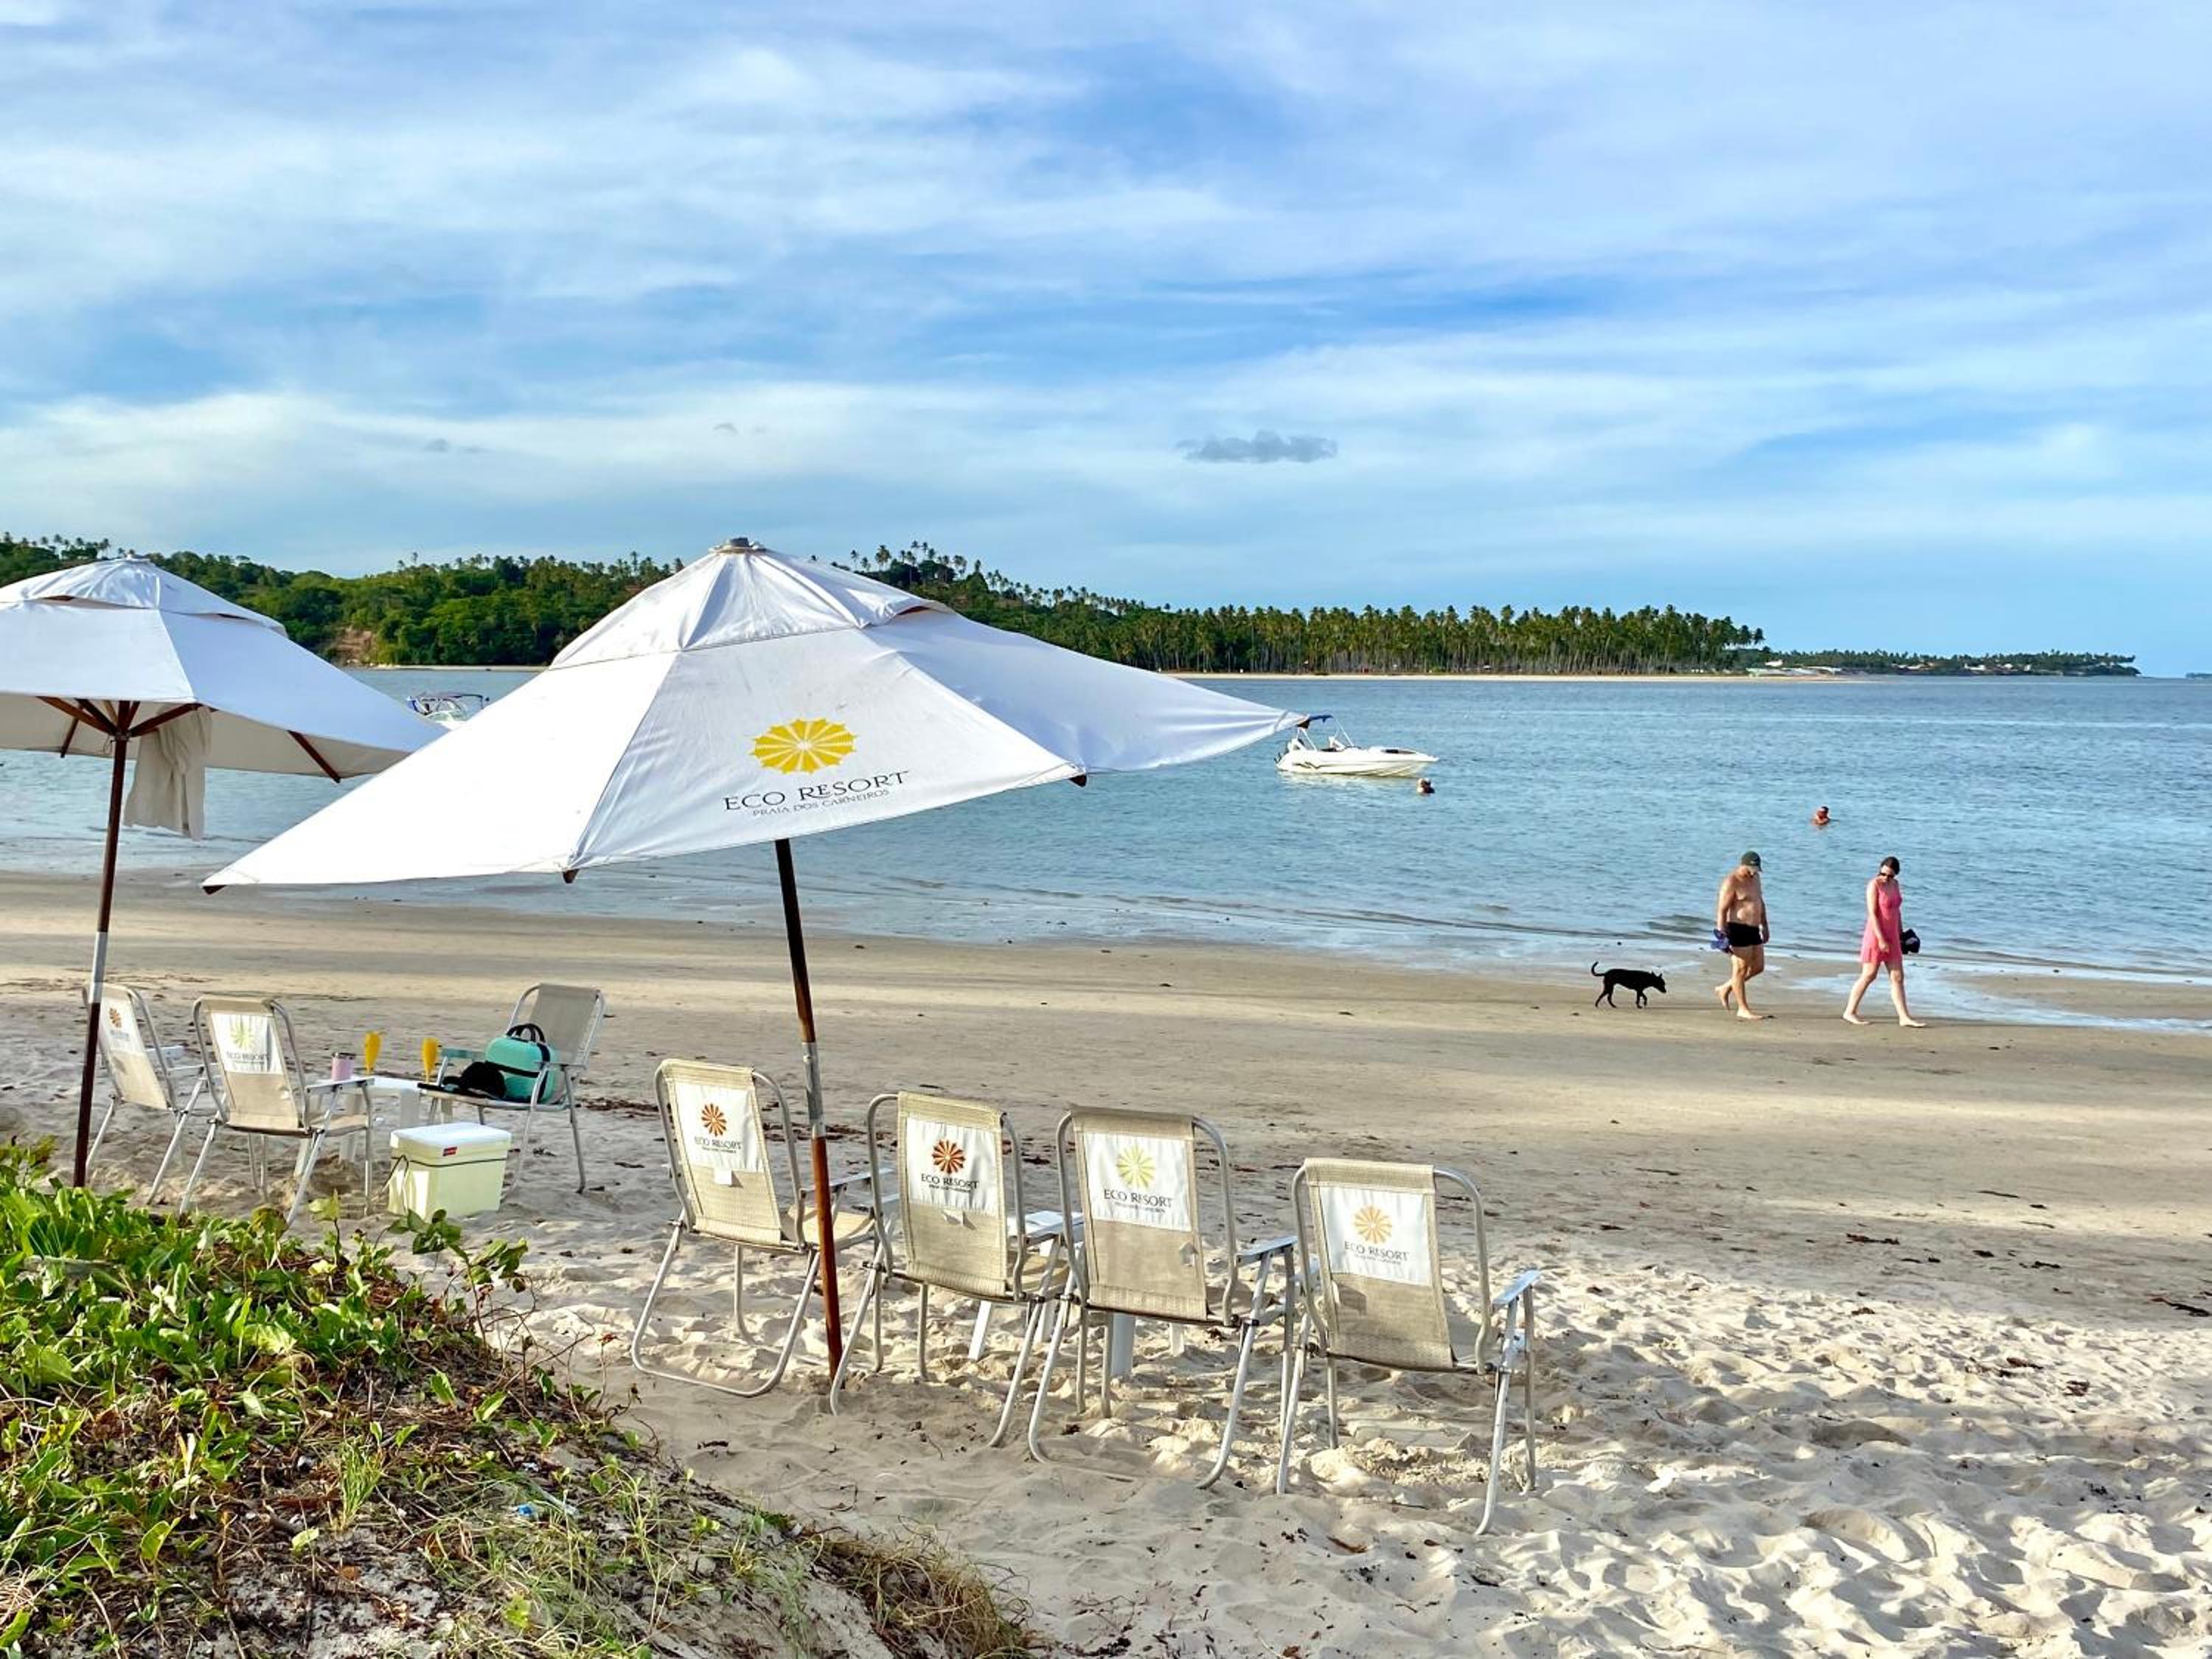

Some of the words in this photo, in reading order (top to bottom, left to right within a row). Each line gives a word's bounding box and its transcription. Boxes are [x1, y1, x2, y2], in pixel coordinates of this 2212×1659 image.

[723, 791, 785, 810] ECO
[799, 771, 908, 801] RESORT
[753, 806, 790, 816] PRAIA
[793, 801, 818, 812] DOS
[821, 789, 889, 807] CARNEIROS
[921, 1173, 940, 1185] ECO
[943, 1178, 979, 1189] RESORT
[1104, 1189, 1127, 1201] ECO
[1130, 1192, 1173, 1208] RESORT
[1344, 1241, 1365, 1254] ECO
[1368, 1245, 1409, 1262] RESORT
